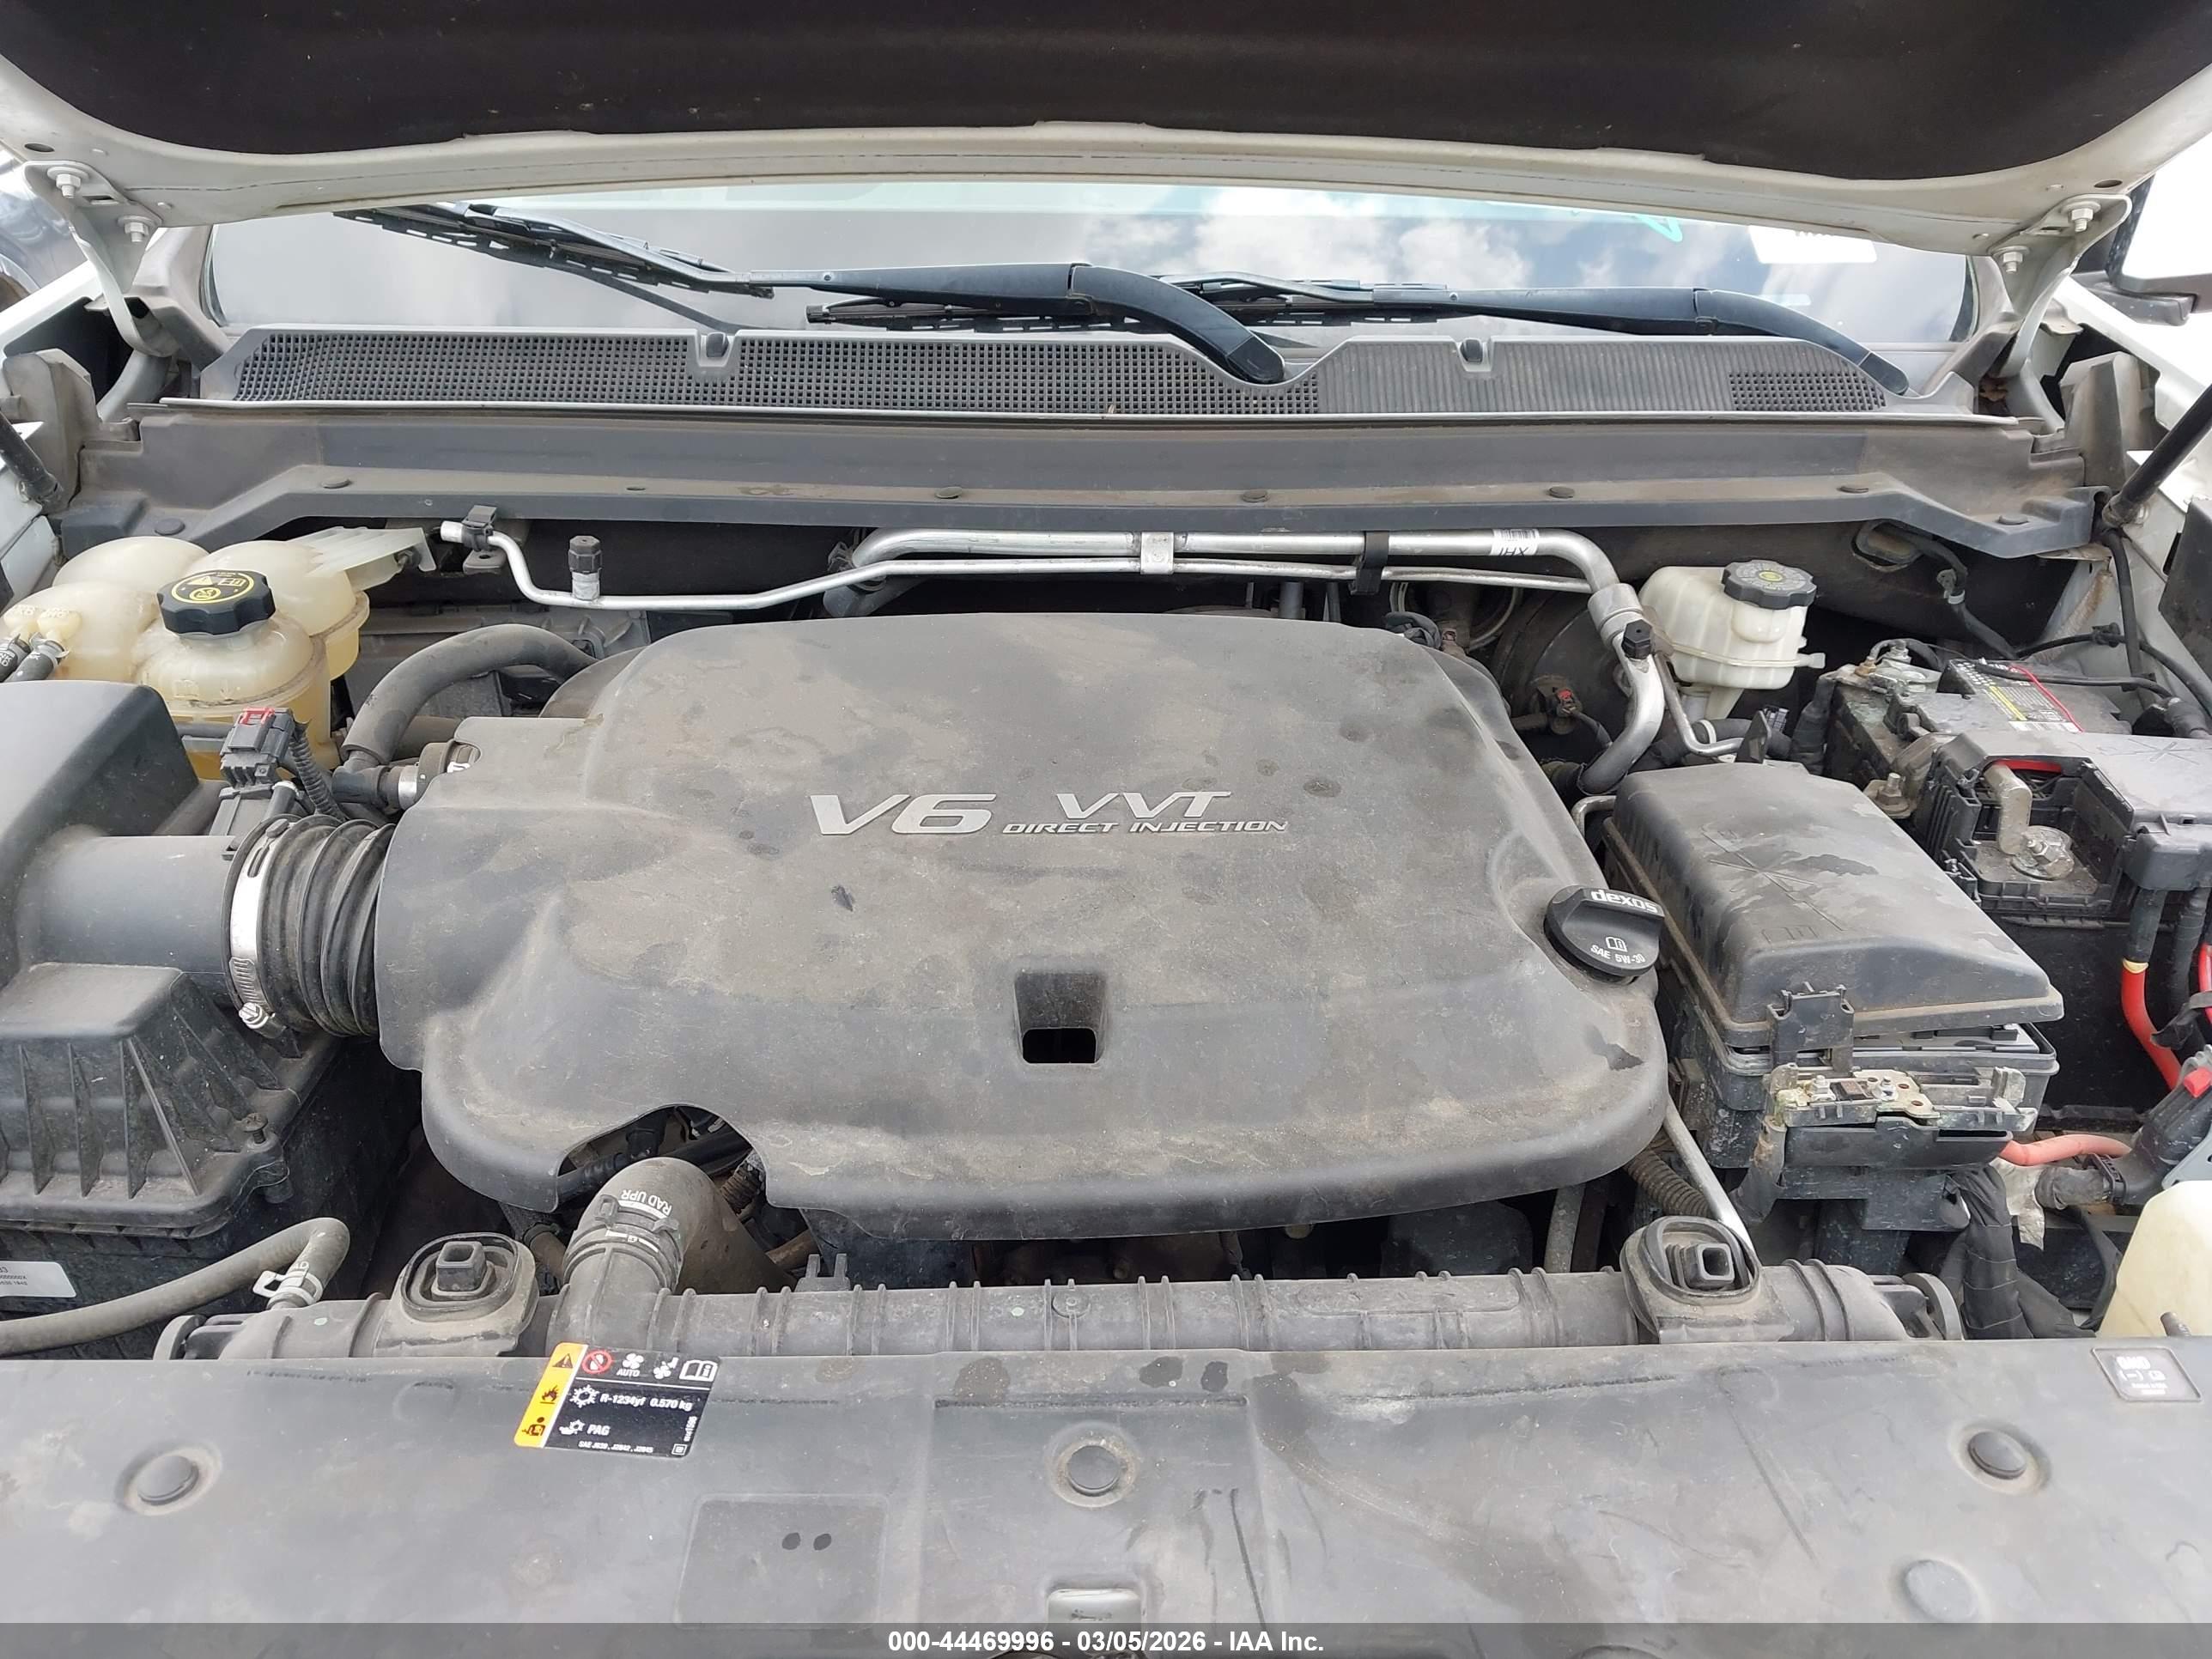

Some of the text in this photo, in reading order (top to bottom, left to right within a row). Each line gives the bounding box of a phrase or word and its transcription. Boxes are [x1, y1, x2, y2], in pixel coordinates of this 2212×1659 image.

[811, 794, 996, 835] V6
[1056, 792, 1231, 819] VVT
[1003, 821, 1288, 834] DIRECT INJECTION
[1590, 889, 1658, 914] dexos
[1590, 945, 1646, 964] SAE 5W-30
[621, 1189, 672, 1216] RAD UPR
[616, 1369, 641, 1377] AUTO
[599, 1393, 693, 1413] R-1234yf 0.570 kg
[586, 1424, 611, 1436] PAG
[578, 1440, 592, 1449] SAE
